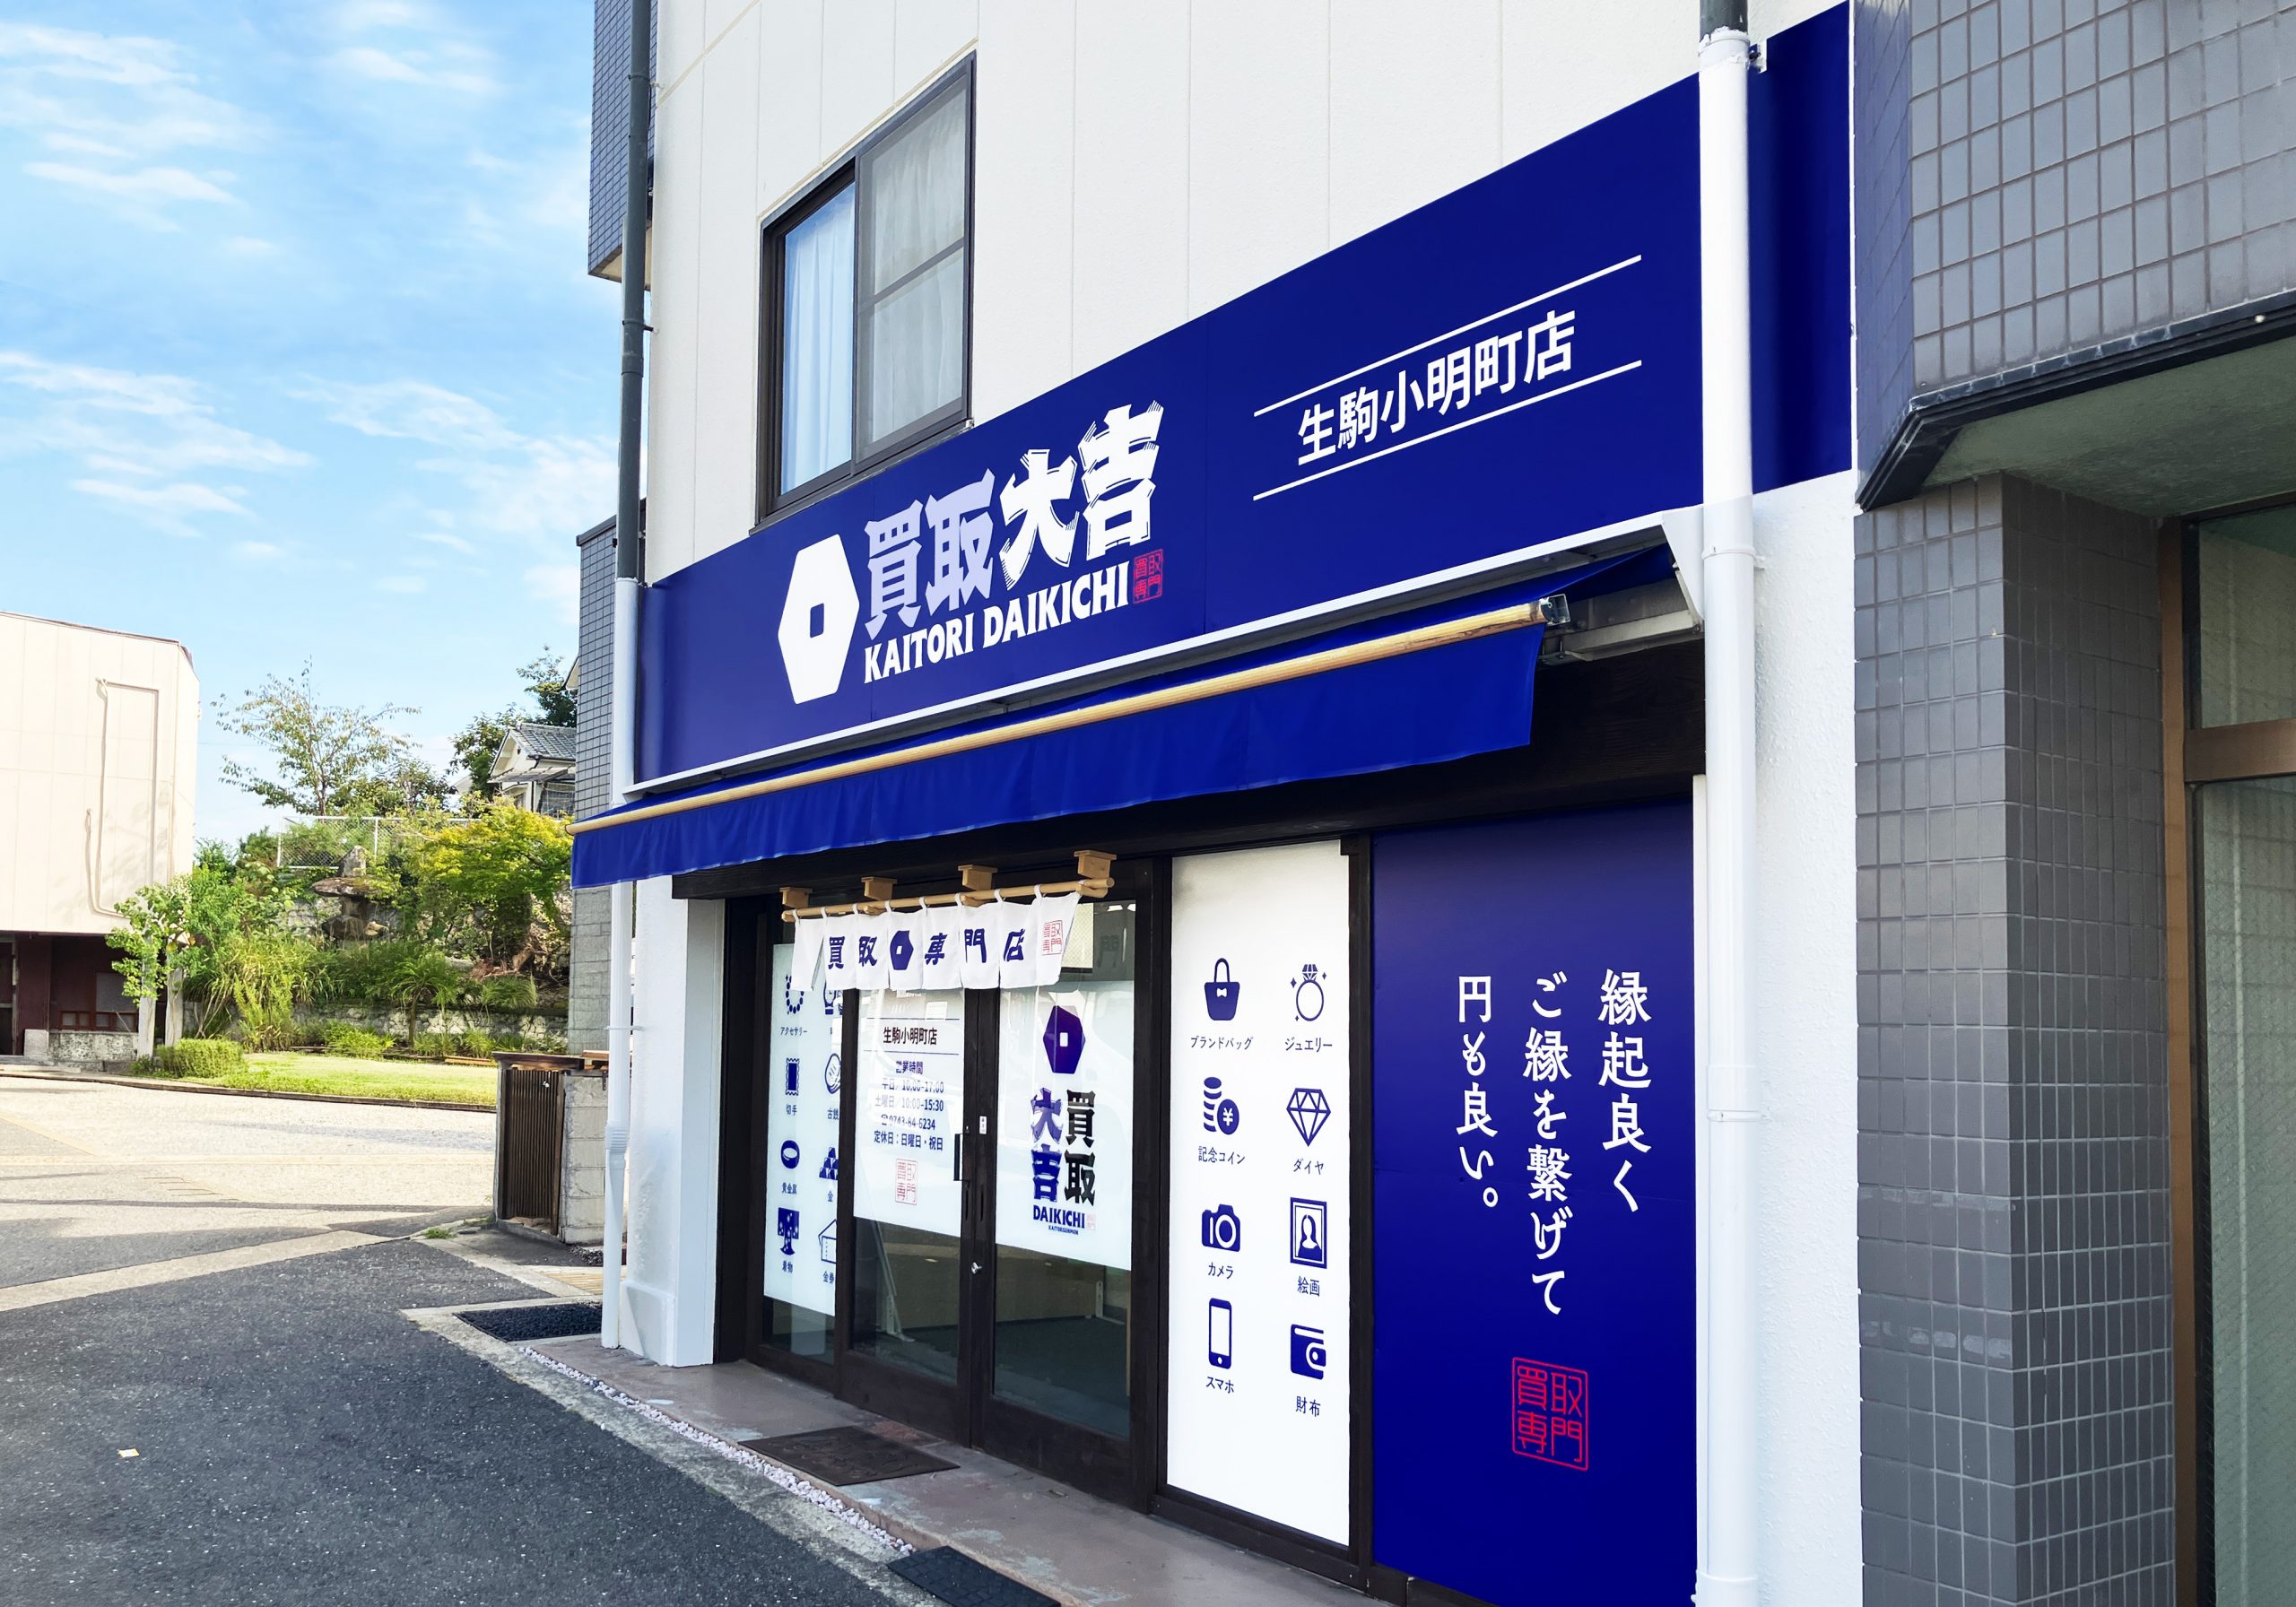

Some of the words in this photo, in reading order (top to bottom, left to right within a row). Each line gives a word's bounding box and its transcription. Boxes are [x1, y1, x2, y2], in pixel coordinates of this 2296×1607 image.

[1298, 309, 1576, 465] 生駒小明町店
[864, 400, 1164, 640] 買取大吉
[864, 612, 975, 684] KAITORI
[982, 560, 1130, 649] DAIKICHI
[779, 1026, 809, 1037] アクセサリー
[883, 1026, 938, 1046] 生駒小明町店
[1190, 1035, 1255, 1050] ブランドバッグ
[1284, 1036, 1333, 1053] ジュエリー
[1456, 975, 1499, 1208] 円も良い。
[1598, 969, 1652, 1212] 縁起良く
[786, 1104, 797, 1116] 切手
[1031, 1087, 1064, 1203] 大吉
[1065, 1089, 1096, 1207] 買取
[1522, 970, 1574, 1316] ご縁を繋げて
[1198, 1145, 1246, 1165] 記念コイン
[1293, 1158, 1324, 1176] ダイヤ
[827, 1190, 833, 1203] 金
[1033, 1204, 1085, 1229] DAIKICHI
[781, 1260, 794, 1273] 着物
[1207, 1262, 1234, 1280] カメラ
[1297, 1275, 1320, 1297] 絵画
[1205, 1376, 1235, 1394] スマホ
[1295, 1395, 1321, 1418] 財布
